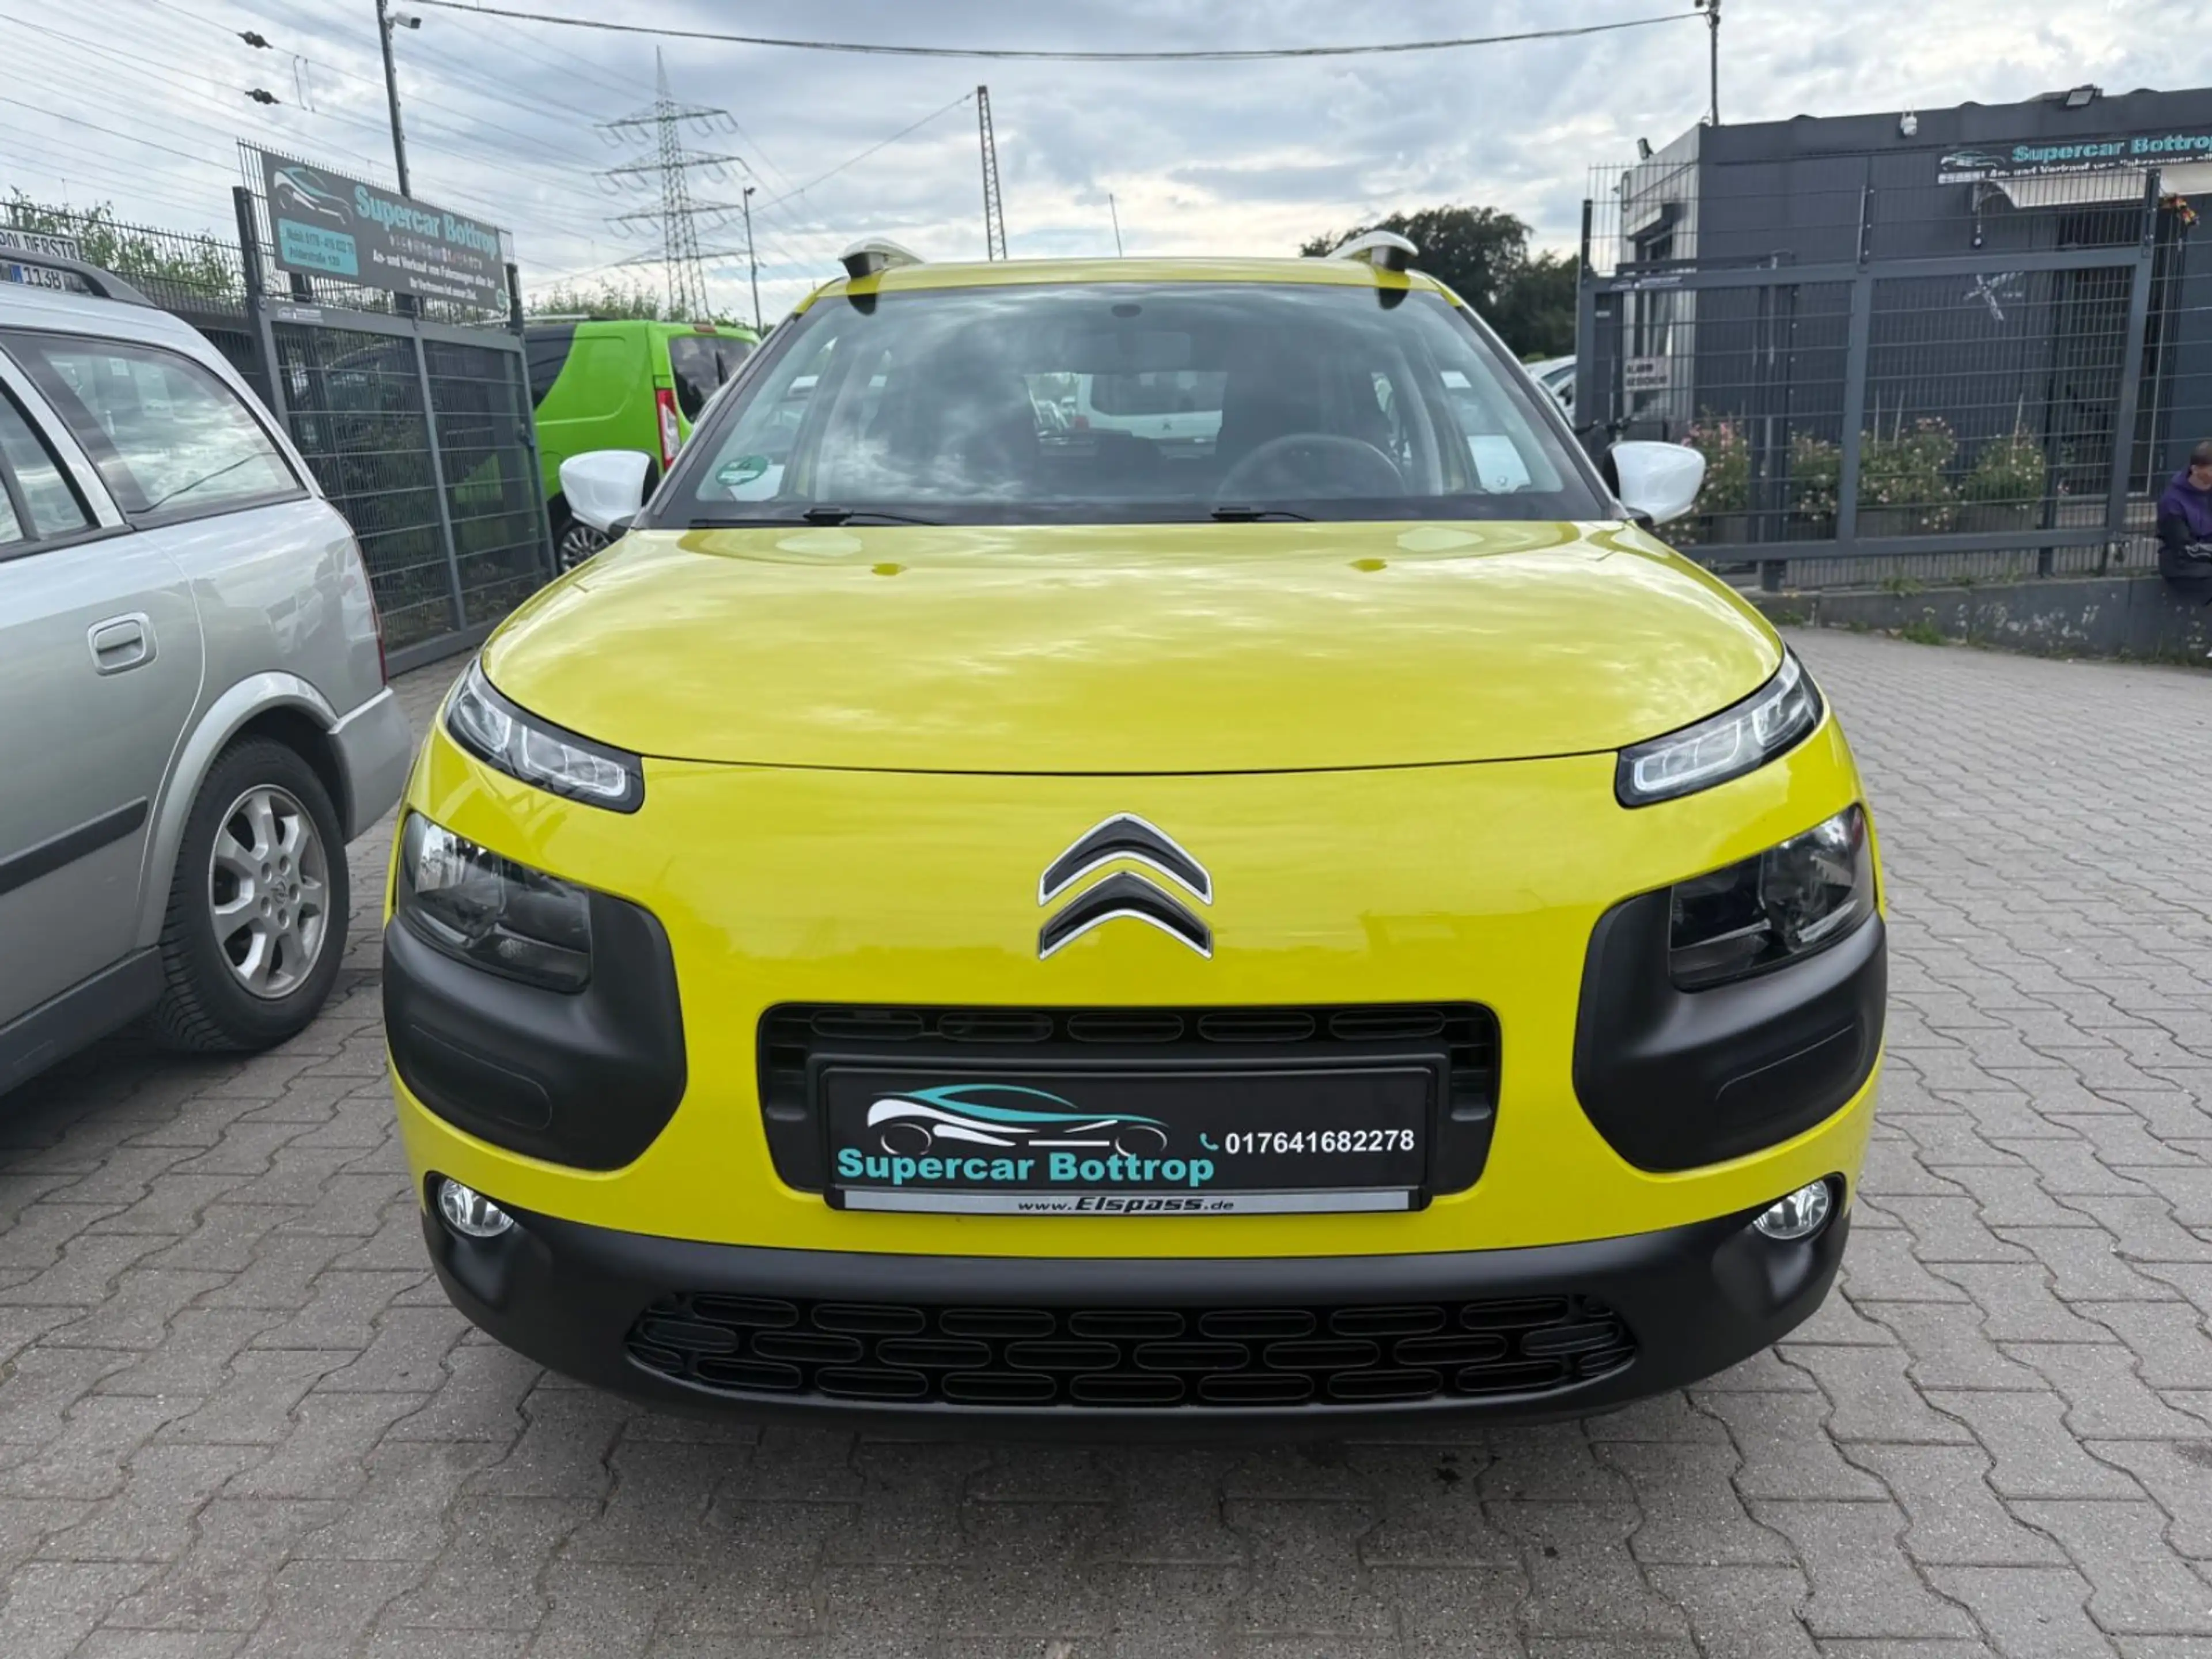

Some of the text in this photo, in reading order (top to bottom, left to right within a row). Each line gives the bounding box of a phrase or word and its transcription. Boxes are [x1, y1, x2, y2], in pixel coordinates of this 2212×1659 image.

[2012, 142, 2124, 164] Supercar
[2040, 162, 2090, 173] Verkauf
[354, 185, 440, 238] Supercar
[443, 213, 498, 260] Bottrop
[1225, 1130, 1415, 1154] 017641682278
[838, 1148, 1214, 1187] Supercar Bottrop
[1018, 1197, 1234, 1213] www.Elspass.de
